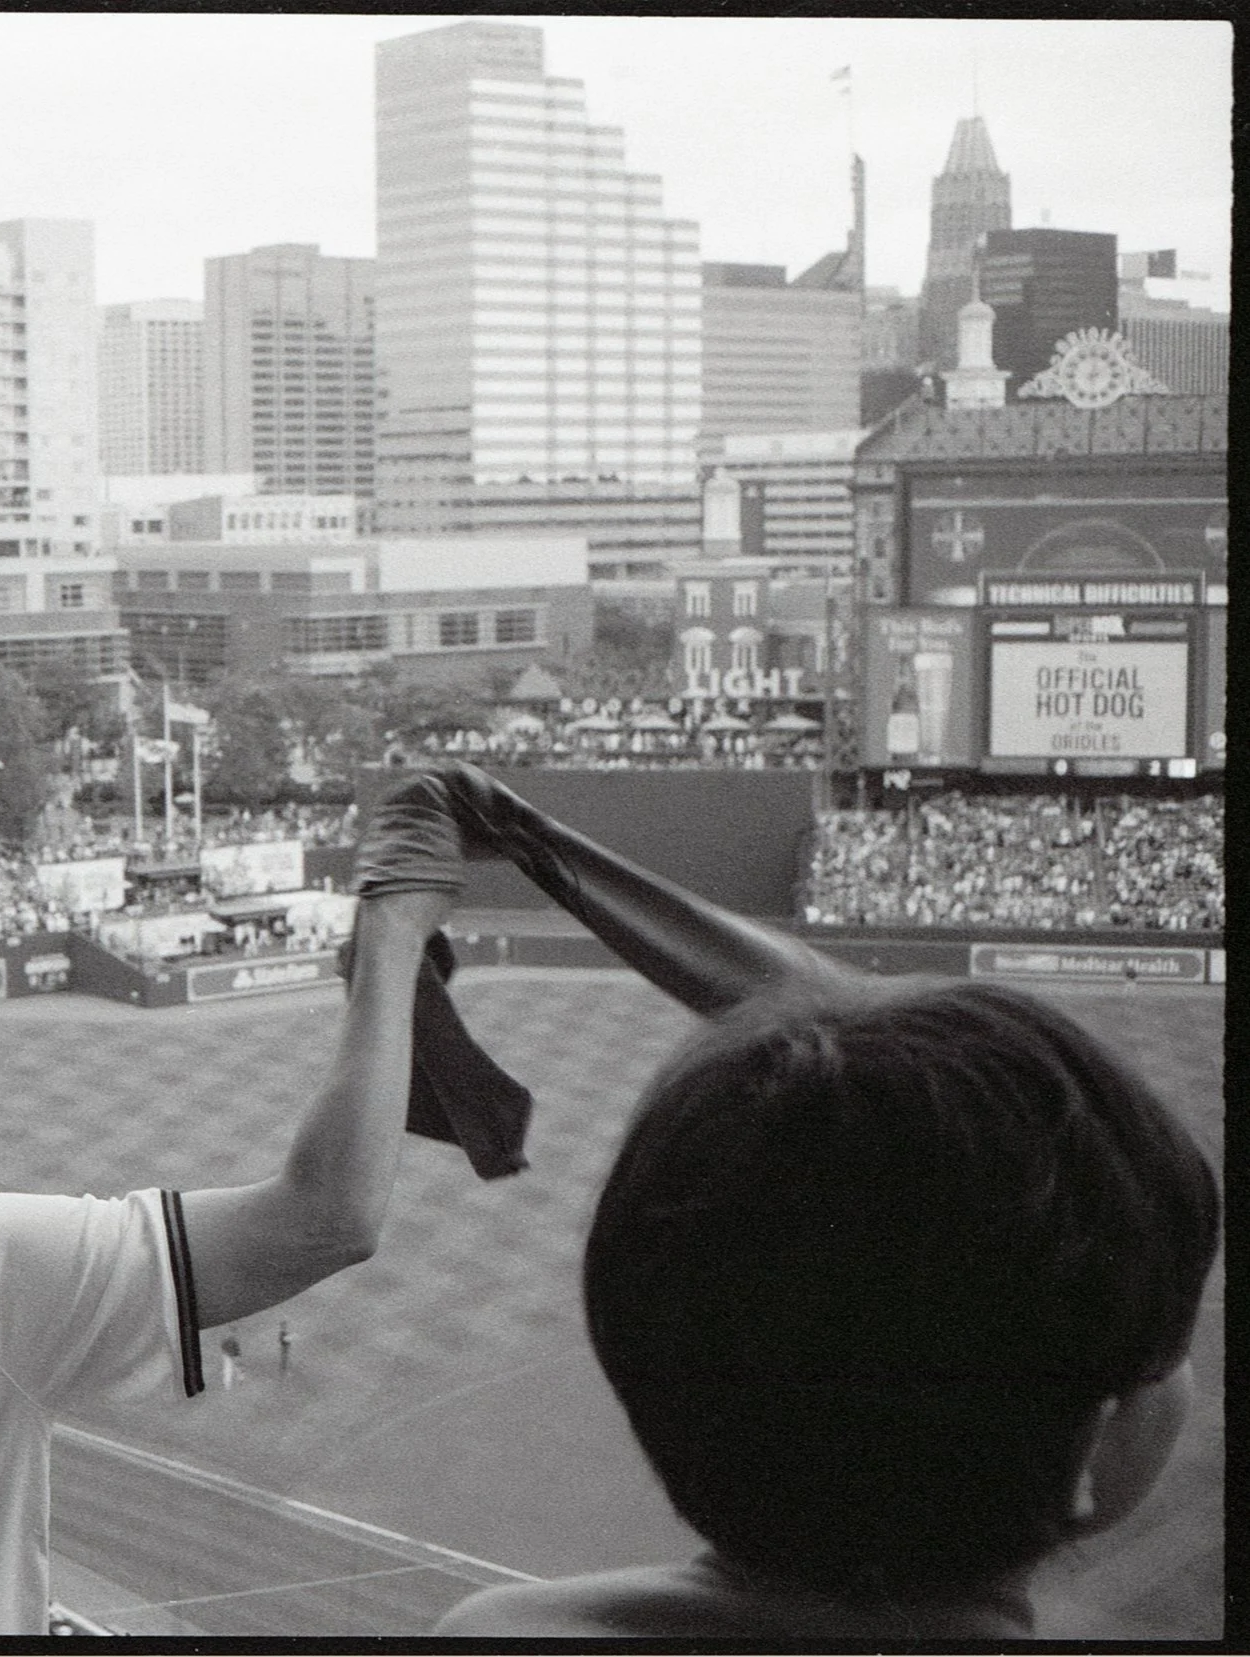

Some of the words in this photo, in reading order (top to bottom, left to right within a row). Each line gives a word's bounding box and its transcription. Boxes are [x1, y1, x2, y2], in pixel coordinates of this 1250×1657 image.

[680, 667, 804, 699] LIGHT
[1037, 667, 1144, 691] OFFICIAL
[1036, 691, 1082, 717] HOT
[1093, 691, 1145, 718] DOG
[1052, 733, 1121, 751] ORIOLES
